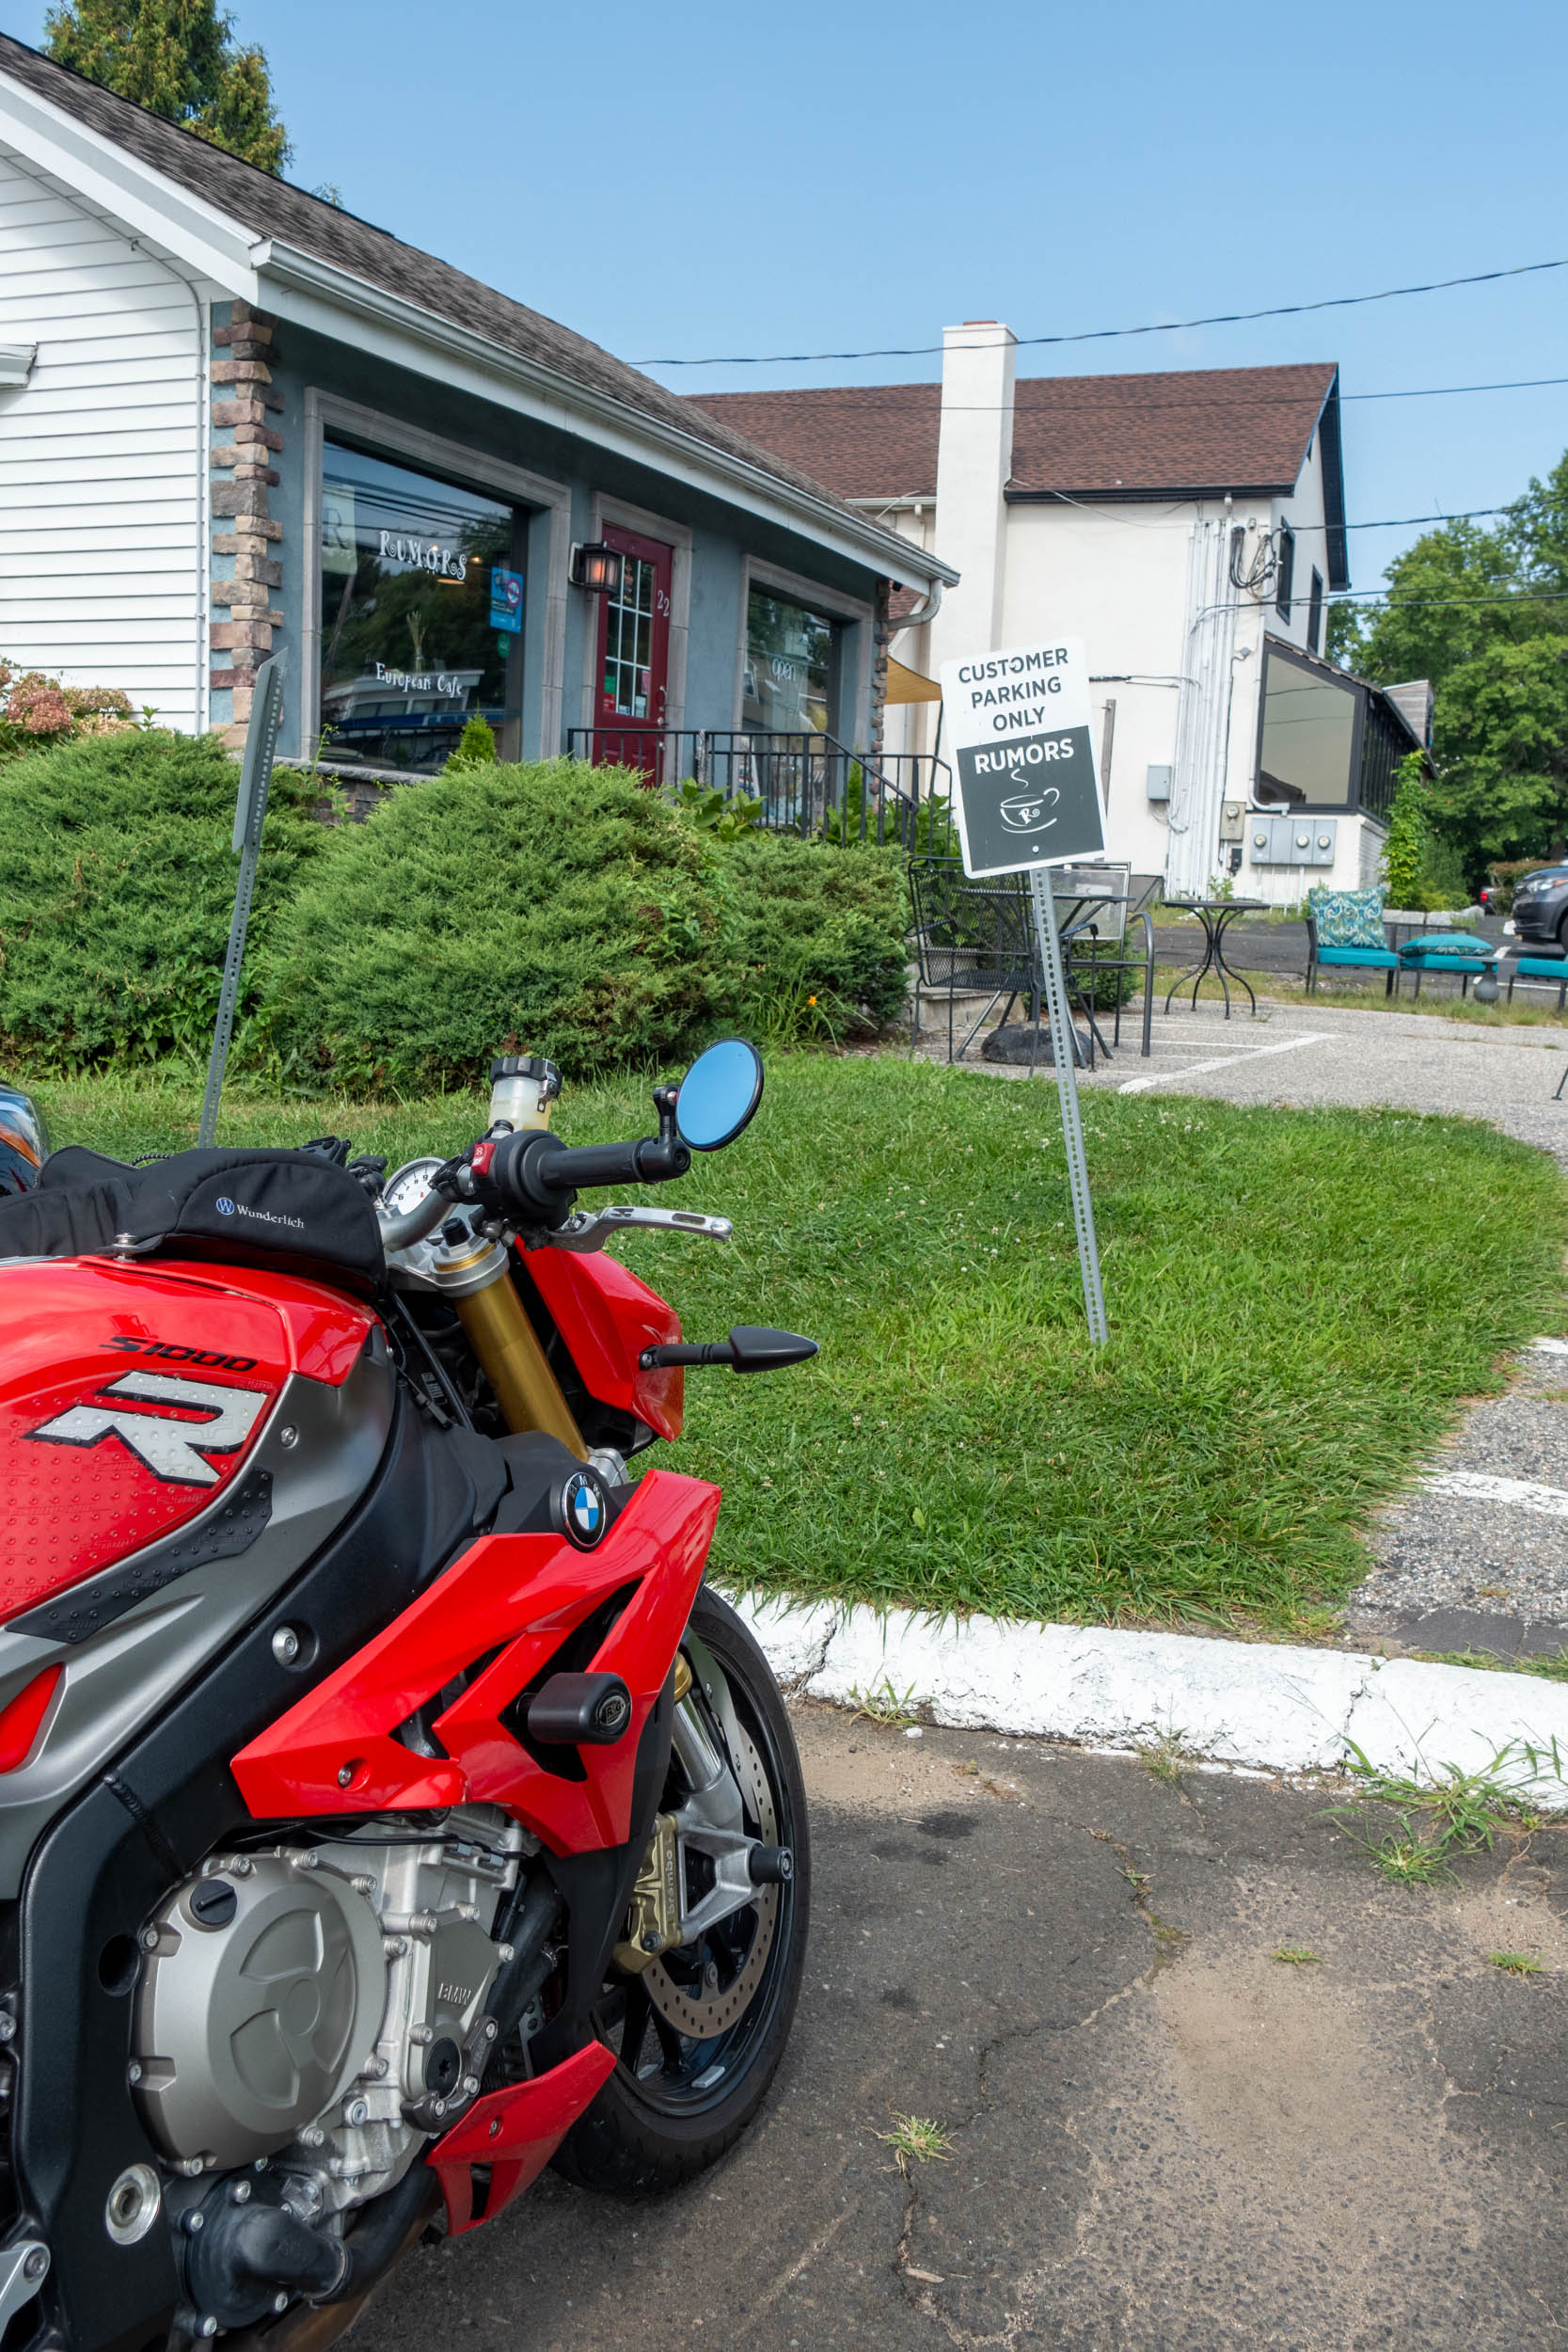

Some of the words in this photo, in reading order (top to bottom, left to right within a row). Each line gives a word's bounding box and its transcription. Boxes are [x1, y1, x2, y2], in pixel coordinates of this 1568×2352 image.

[657, 589, 671, 617] 22
[375, 661, 432, 693] European
[436, 674, 463, 698] Cafe
[771, 658, 797, 683] open
[958, 647, 1069, 684] CUSTOMER
[971, 675, 1062, 709] PARKING
[992, 706, 1046, 732] ONLY
[974, 737, 1075, 775] RUMORS
[1018, 807, 1041, 825] R
[236, 1203, 306, 1230] Wunderlich
[97, 1335, 260, 1373] S1000
[21, 1369, 271, 1489] R
[665, 1849, 675, 1915] brembo
[437, 1982, 472, 2006] BMW
